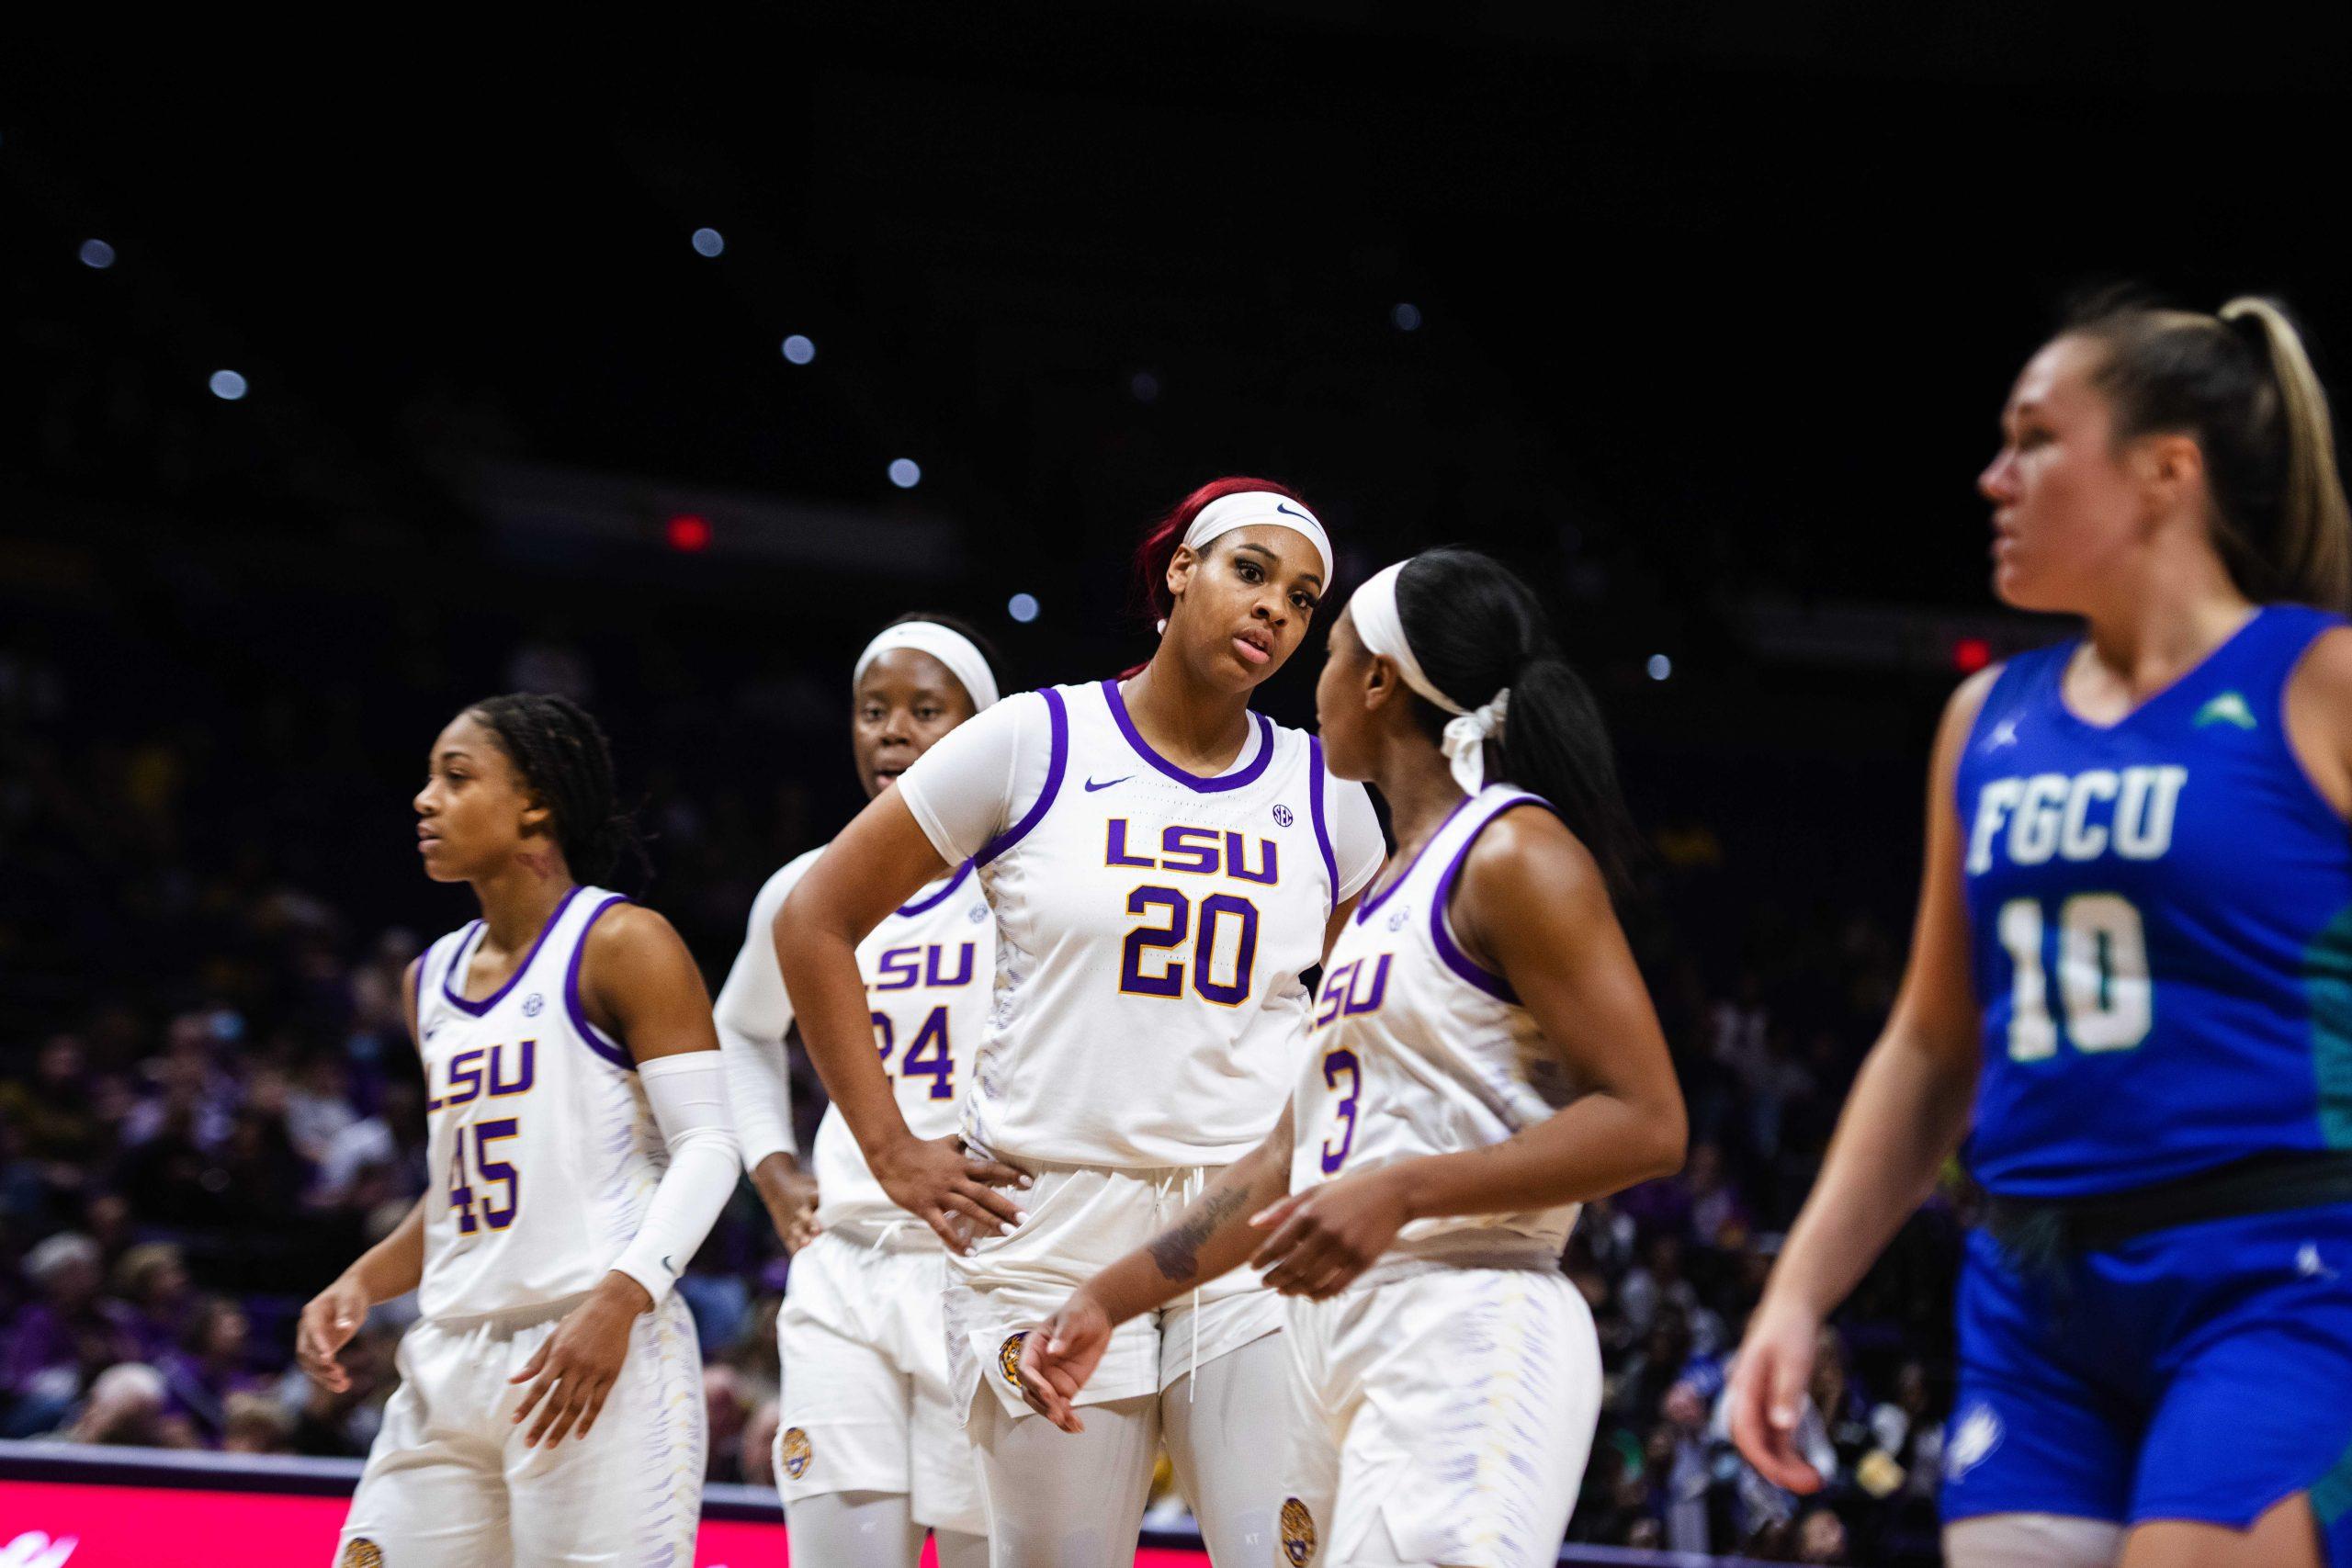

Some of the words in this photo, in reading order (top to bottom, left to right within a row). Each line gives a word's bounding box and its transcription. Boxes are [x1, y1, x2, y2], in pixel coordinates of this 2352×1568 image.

[1104, 818, 1278, 887] LSU
[1273, 805, 1293, 826] SEC
[1965, 765, 2188, 876] FGCU
[865, 942, 976, 991] SU
[1117, 885, 1260, 1008] 20
[1306, 952, 1394, 1038] SU
[1997, 890, 2153, 1063] 10
[1321, 1046, 1361, 1177] 3
[448, 1117, 519, 1235] 45
